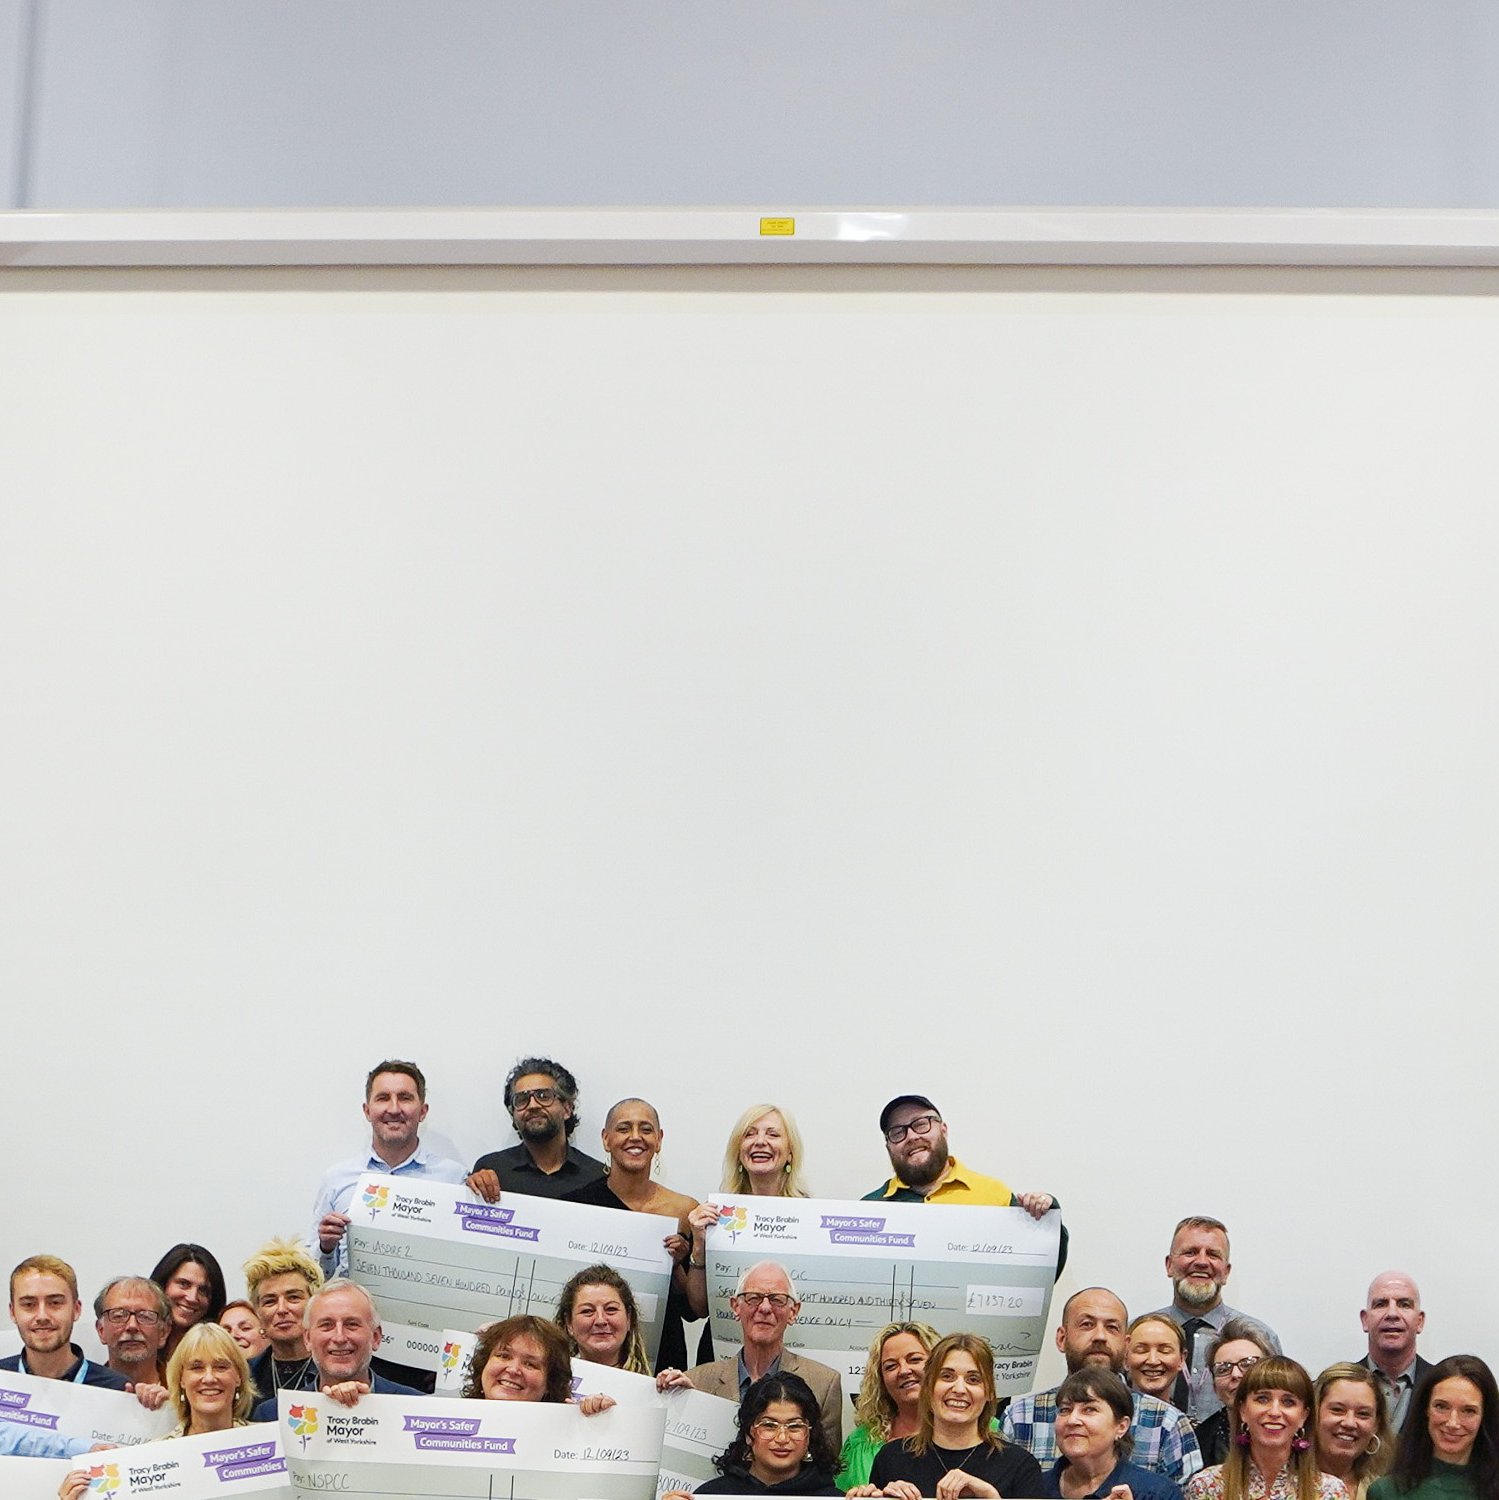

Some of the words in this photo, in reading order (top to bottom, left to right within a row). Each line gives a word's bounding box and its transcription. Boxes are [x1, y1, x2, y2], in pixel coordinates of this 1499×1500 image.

[392, 1201, 423, 1215] Mayor
[459, 1205, 490, 1218] Mayor's
[491, 1209, 510, 1219] Safer
[755, 1214, 775, 1225] Tracy
[776, 1216, 800, 1224] Brabin
[826, 1217, 858, 1230] Mayor's
[859, 1219, 881, 1229] Safer
[465, 1220, 513, 1236] Communities
[515, 1228, 534, 1239] Fund
[753, 1221, 787, 1234] Mayor
[568, 1240, 588, 1252] Date:
[834, 1233, 888, 1245] Communities
[888, 1235, 910, 1245] Fund
[326, 1416, 350, 1427] Tracy
[351, 1417, 379, 1426] Brabin
[410, 1418, 447, 1432] Mayor's
[448, 1420, 475, 1431] Safer
[326, 1424, 365, 1438] Mayor
[419, 1437, 482, 1451] Communities
[484, 1439, 508, 1451] Fund
[553, 1449, 578, 1461] Date:
[128, 1465, 152, 1479] Tracy
[153, 1462, 180, 1474] Brabin
[129, 1472, 167, 1487] Mayor
[308, 1473, 350, 1490] NSPCC
